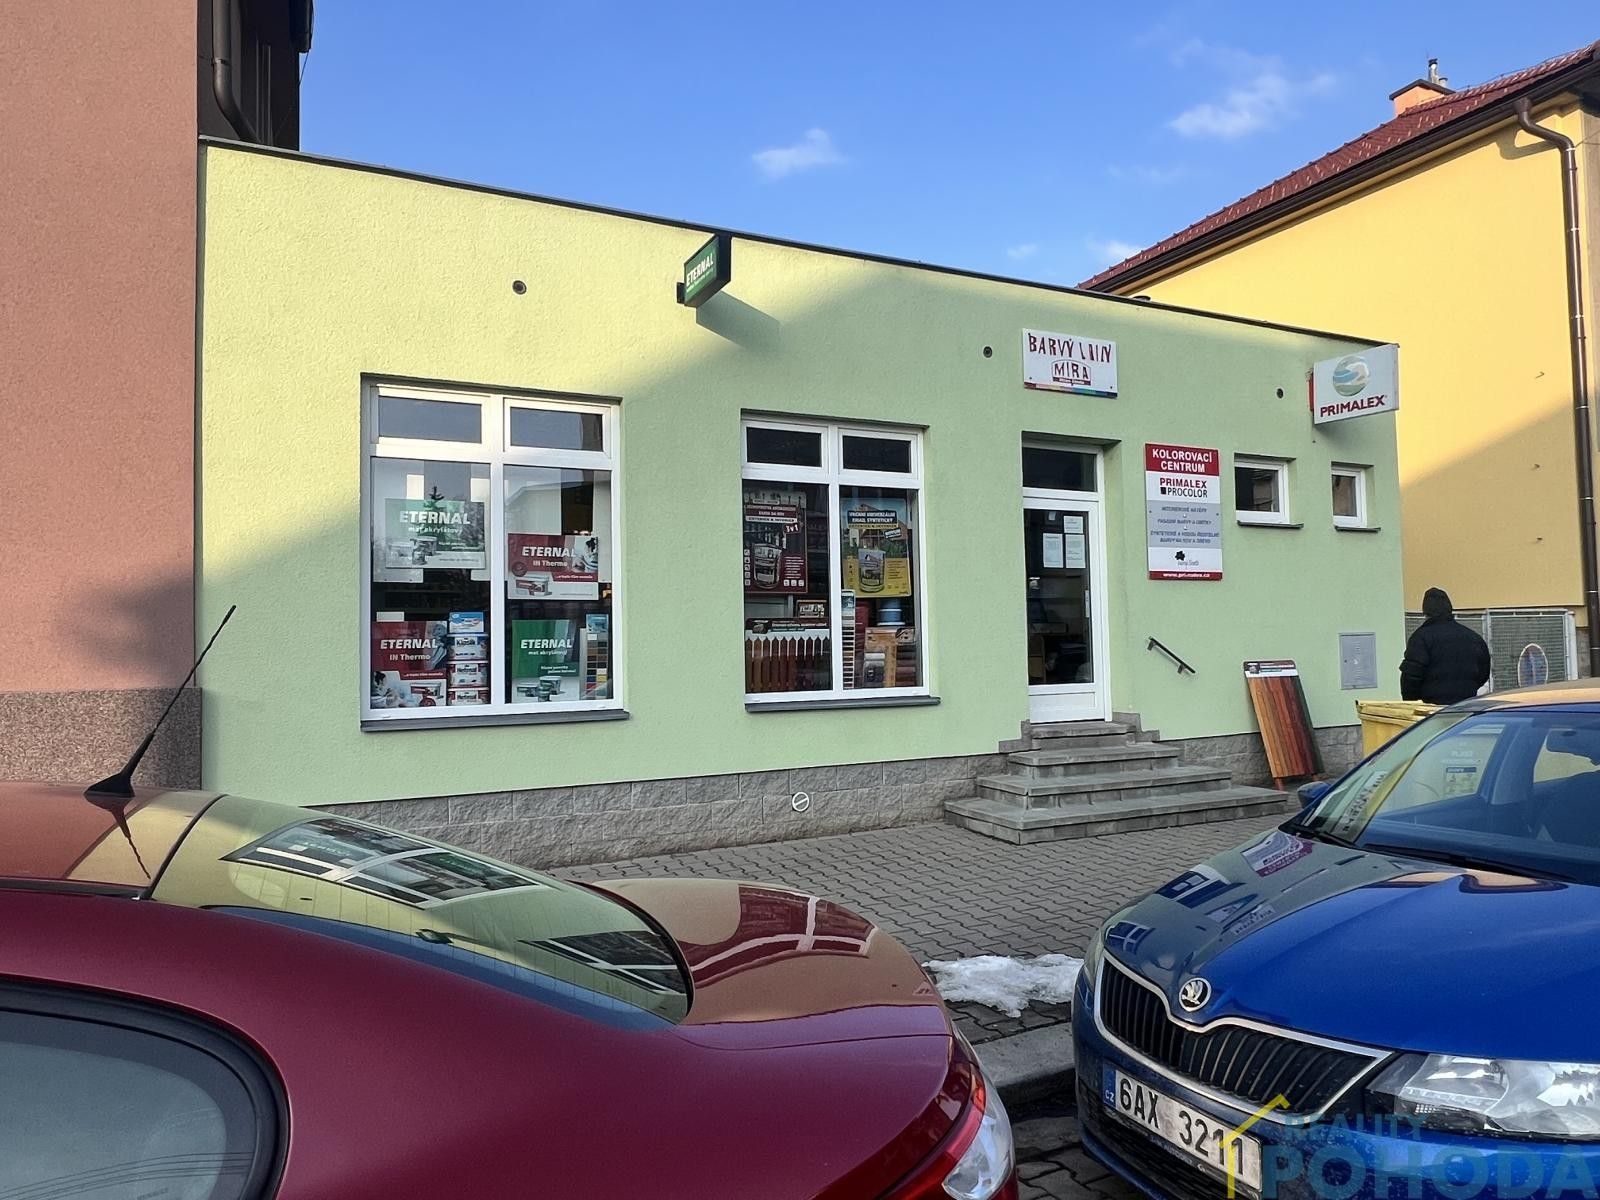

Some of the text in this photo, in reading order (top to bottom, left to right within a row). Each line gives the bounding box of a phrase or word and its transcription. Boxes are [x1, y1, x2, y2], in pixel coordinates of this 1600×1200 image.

[686, 252, 714, 287] ETERNAL
[1320, 395, 1385, 418] PRIMALEX
[1152, 449, 1213, 463] KOLOROVACÍ
[1160, 460, 1206, 473] CENTRUM
[1159, 477, 1208, 489] PRIMALEX
[1167, 487, 1208, 498] PROCOLOR
[399, 510, 471, 525] ETERNAL
[521, 546, 577, 557] ETERNAL
[380, 638, 439, 650] ETERNAL
[520, 639, 574, 649] ETERNAL
[389, 653, 431, 661] IN Thermo
[1105, 1089, 1115, 1102] CZ
[1119, 1077, 1160, 1130] 6AX
[1178, 1109, 1244, 1176] 3211
